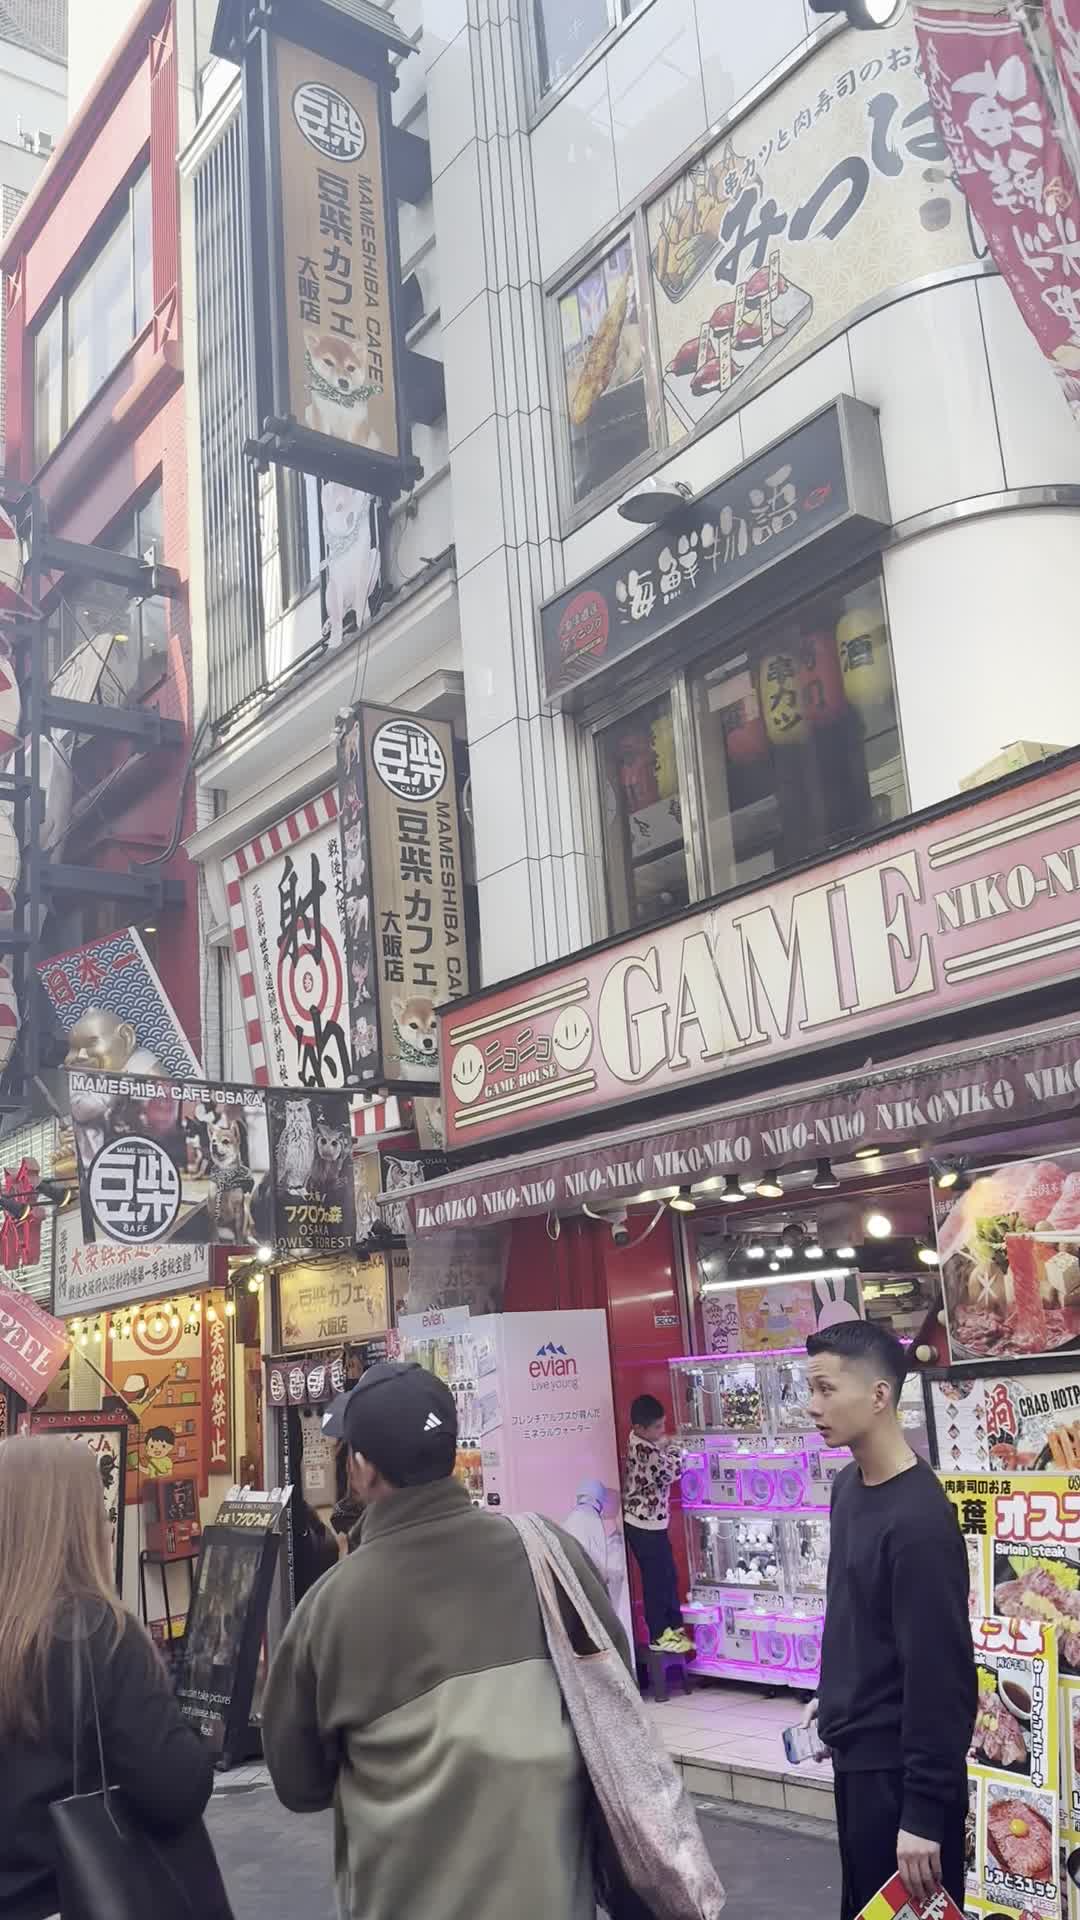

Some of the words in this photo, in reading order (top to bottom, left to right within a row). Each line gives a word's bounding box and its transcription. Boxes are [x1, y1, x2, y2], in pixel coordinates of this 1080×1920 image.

[724, 45, 924, 195] 串カツと肉寿司のお
[357, 174, 380, 309] MAMESHIBA
[297, 255, 321, 326] 大阪店
[366, 316, 384, 384] CAFE
[615, 463, 798, 625] 海鮮物語
[400, 784, 421, 794] CAFE
[435, 801, 460, 946] MAMESHIBA
[397, 806, 438, 987] 豆柴カフェ
[381, 910, 405, 983] 大阪店
[598, 848, 938, 1085] GAME
[485, 1026, 551, 1074] ニコニコ
[73, 1076, 167, 1099] MAMESHIBA
[171, 1086, 210, 1103] CAFE
[214, 1090, 264, 1107] OSAKA
[484, 1077, 517, 1098] GAME
[518, 1063, 558, 1087] HOUSE
[481, 1178, 556, 1216] NIKO-NIKO
[759, 1110, 865, 1157] NIKO-NIKO
[95, 1153, 177, 1223] 豆柴
[122, 1223, 148, 1234] CAFE
[284, 1205, 343, 1224] フクロウの森
[299, 1224, 329, 1236] OSAKA
[316, 1236, 353, 1249] FOREST
[421, 1310, 446, 1328] evian
[529, 1356, 578, 1378] evian
[1018, 1392, 1051, 1419] CRAB
[944, 1479, 1012, 1495] 肉寿司のお店
[994, 1543, 1029, 1557] Sirloin
[1031, 1544, 1066, 1558] steak
[1031, 1658, 1044, 1788] サーロインステーキ
[983, 1865, 1058, 1900] レアとろユッケ
